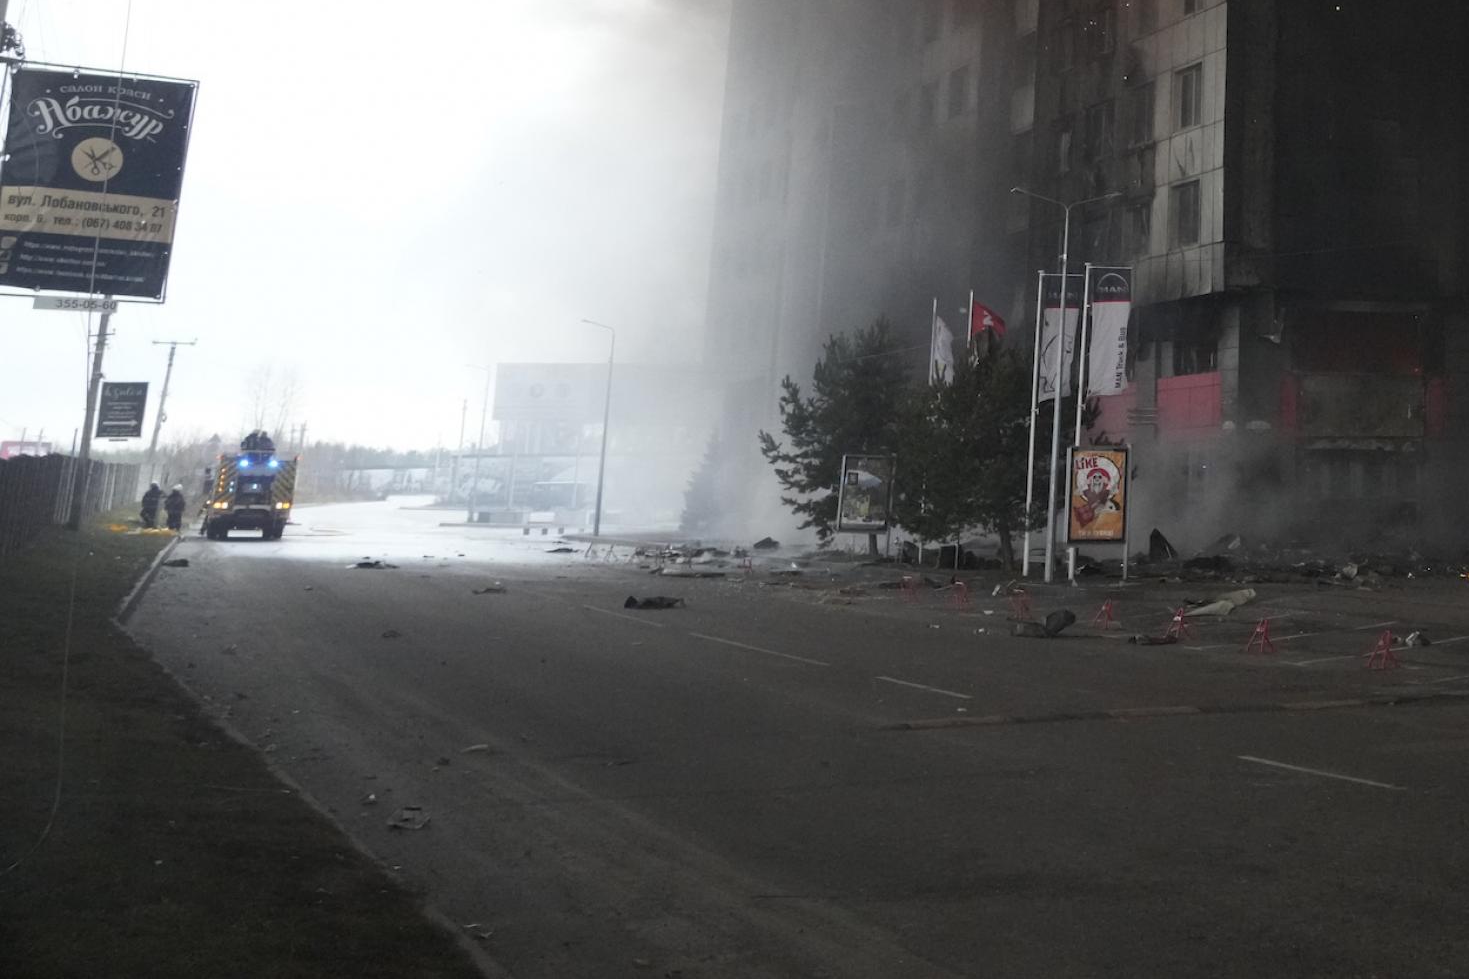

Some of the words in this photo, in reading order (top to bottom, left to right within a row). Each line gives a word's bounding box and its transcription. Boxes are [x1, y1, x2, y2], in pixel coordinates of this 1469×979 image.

[8, 194, 36, 208] вул.
[152, 205, 165, 218] 21
[1097, 285, 1129, 293] MAN
[55, 299, 117, 310] 355-05-60
[1115, 373, 1123, 388] MAN
